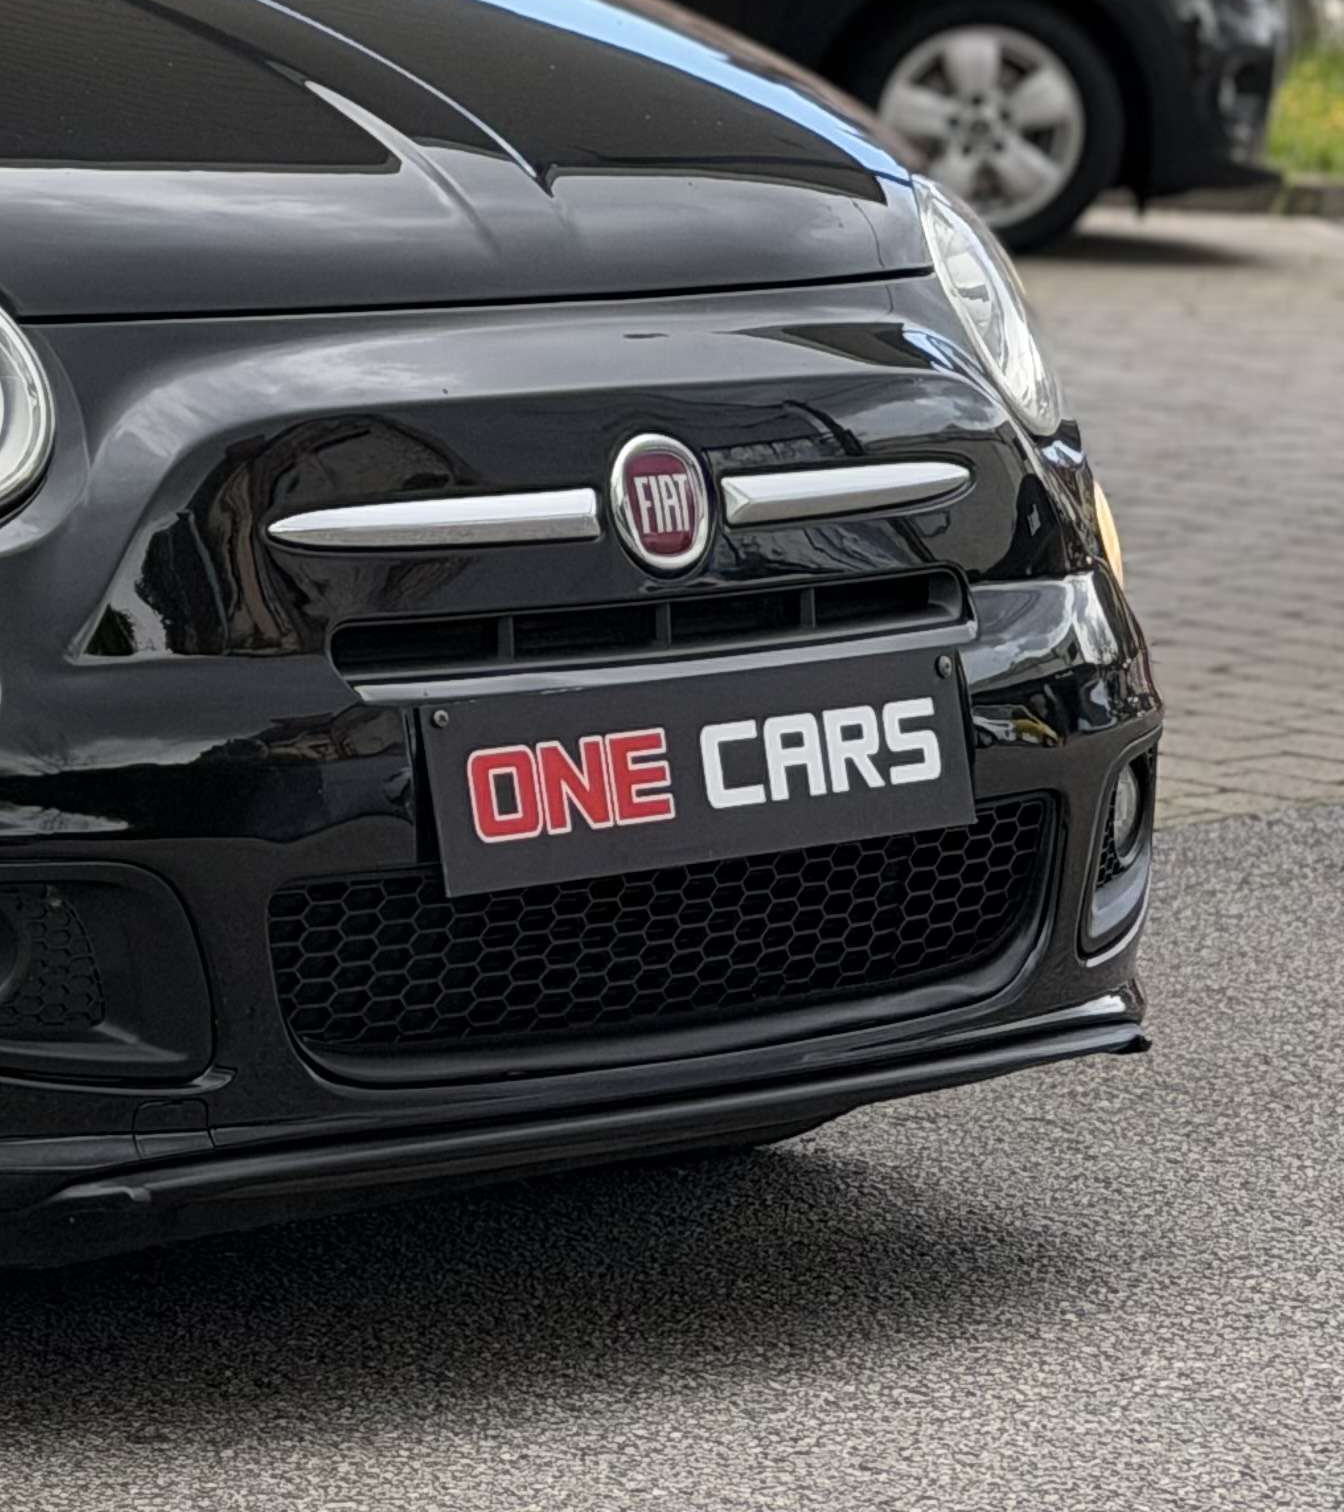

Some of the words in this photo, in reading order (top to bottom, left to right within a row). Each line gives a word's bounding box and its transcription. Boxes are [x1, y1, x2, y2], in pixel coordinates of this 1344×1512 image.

[633, 473, 691, 535] FIAT
[467, 727, 676, 844] ONE
[699, 696, 943, 810] CARS
